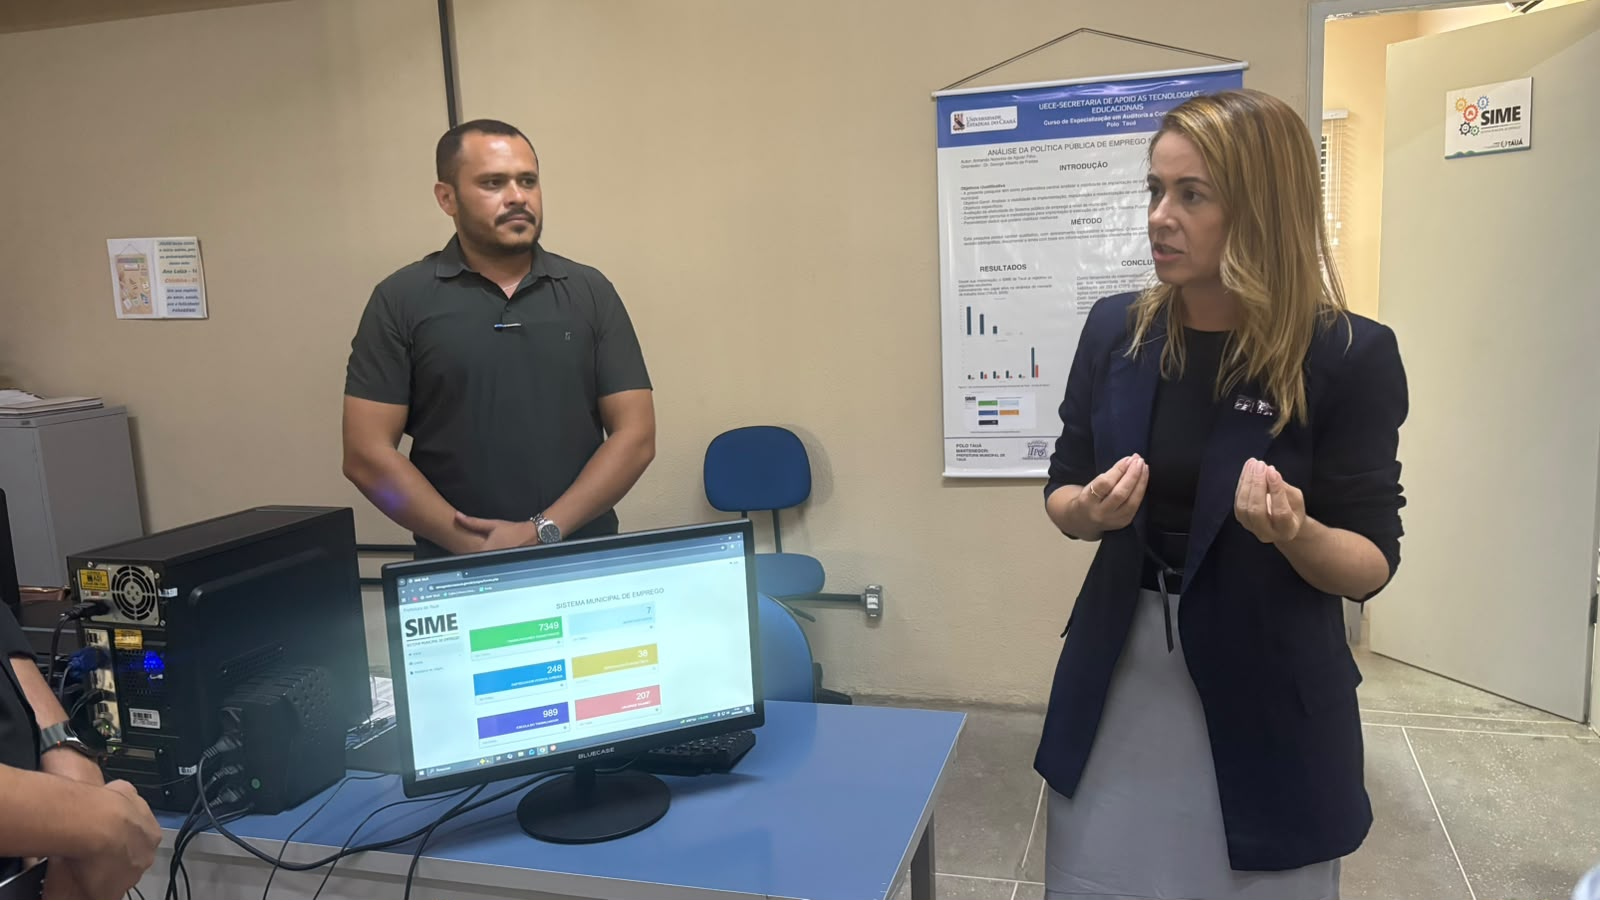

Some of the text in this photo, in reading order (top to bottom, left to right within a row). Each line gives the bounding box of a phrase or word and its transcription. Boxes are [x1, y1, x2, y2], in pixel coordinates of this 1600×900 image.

[1103, 97, 1113, 105] DE
[1114, 95, 1137, 104] APOIO
[1091, 103, 1144, 114] EDUCACIONAIS
[1480, 105, 1521, 126] SIME
[987, 147, 1017, 156] ANÁLISE
[1030, 144, 1062, 153] POLÍTICA
[1097, 140, 1107, 148] DE
[1109, 137, 1147, 147] EMPREGO
[1059, 161, 1109, 172] INTRODUÇÃO
[1070, 216, 1103, 226] MÉTODO
[979, 263, 1027, 273] RESULTADOS
[556, 587, 665, 610] SISTEMA MUNICIPAL DE EMPREGO
[647, 606, 652, 614] 7
[404, 612, 458, 638] SIME
[538, 621, 560, 632] 7349
[637, 649, 648, 658] 38
[546, 664, 562, 674] 248
[635, 690, 650, 700] 207
[542, 708, 558, 718] 989
[577, 746, 615, 760] BLUECASE
